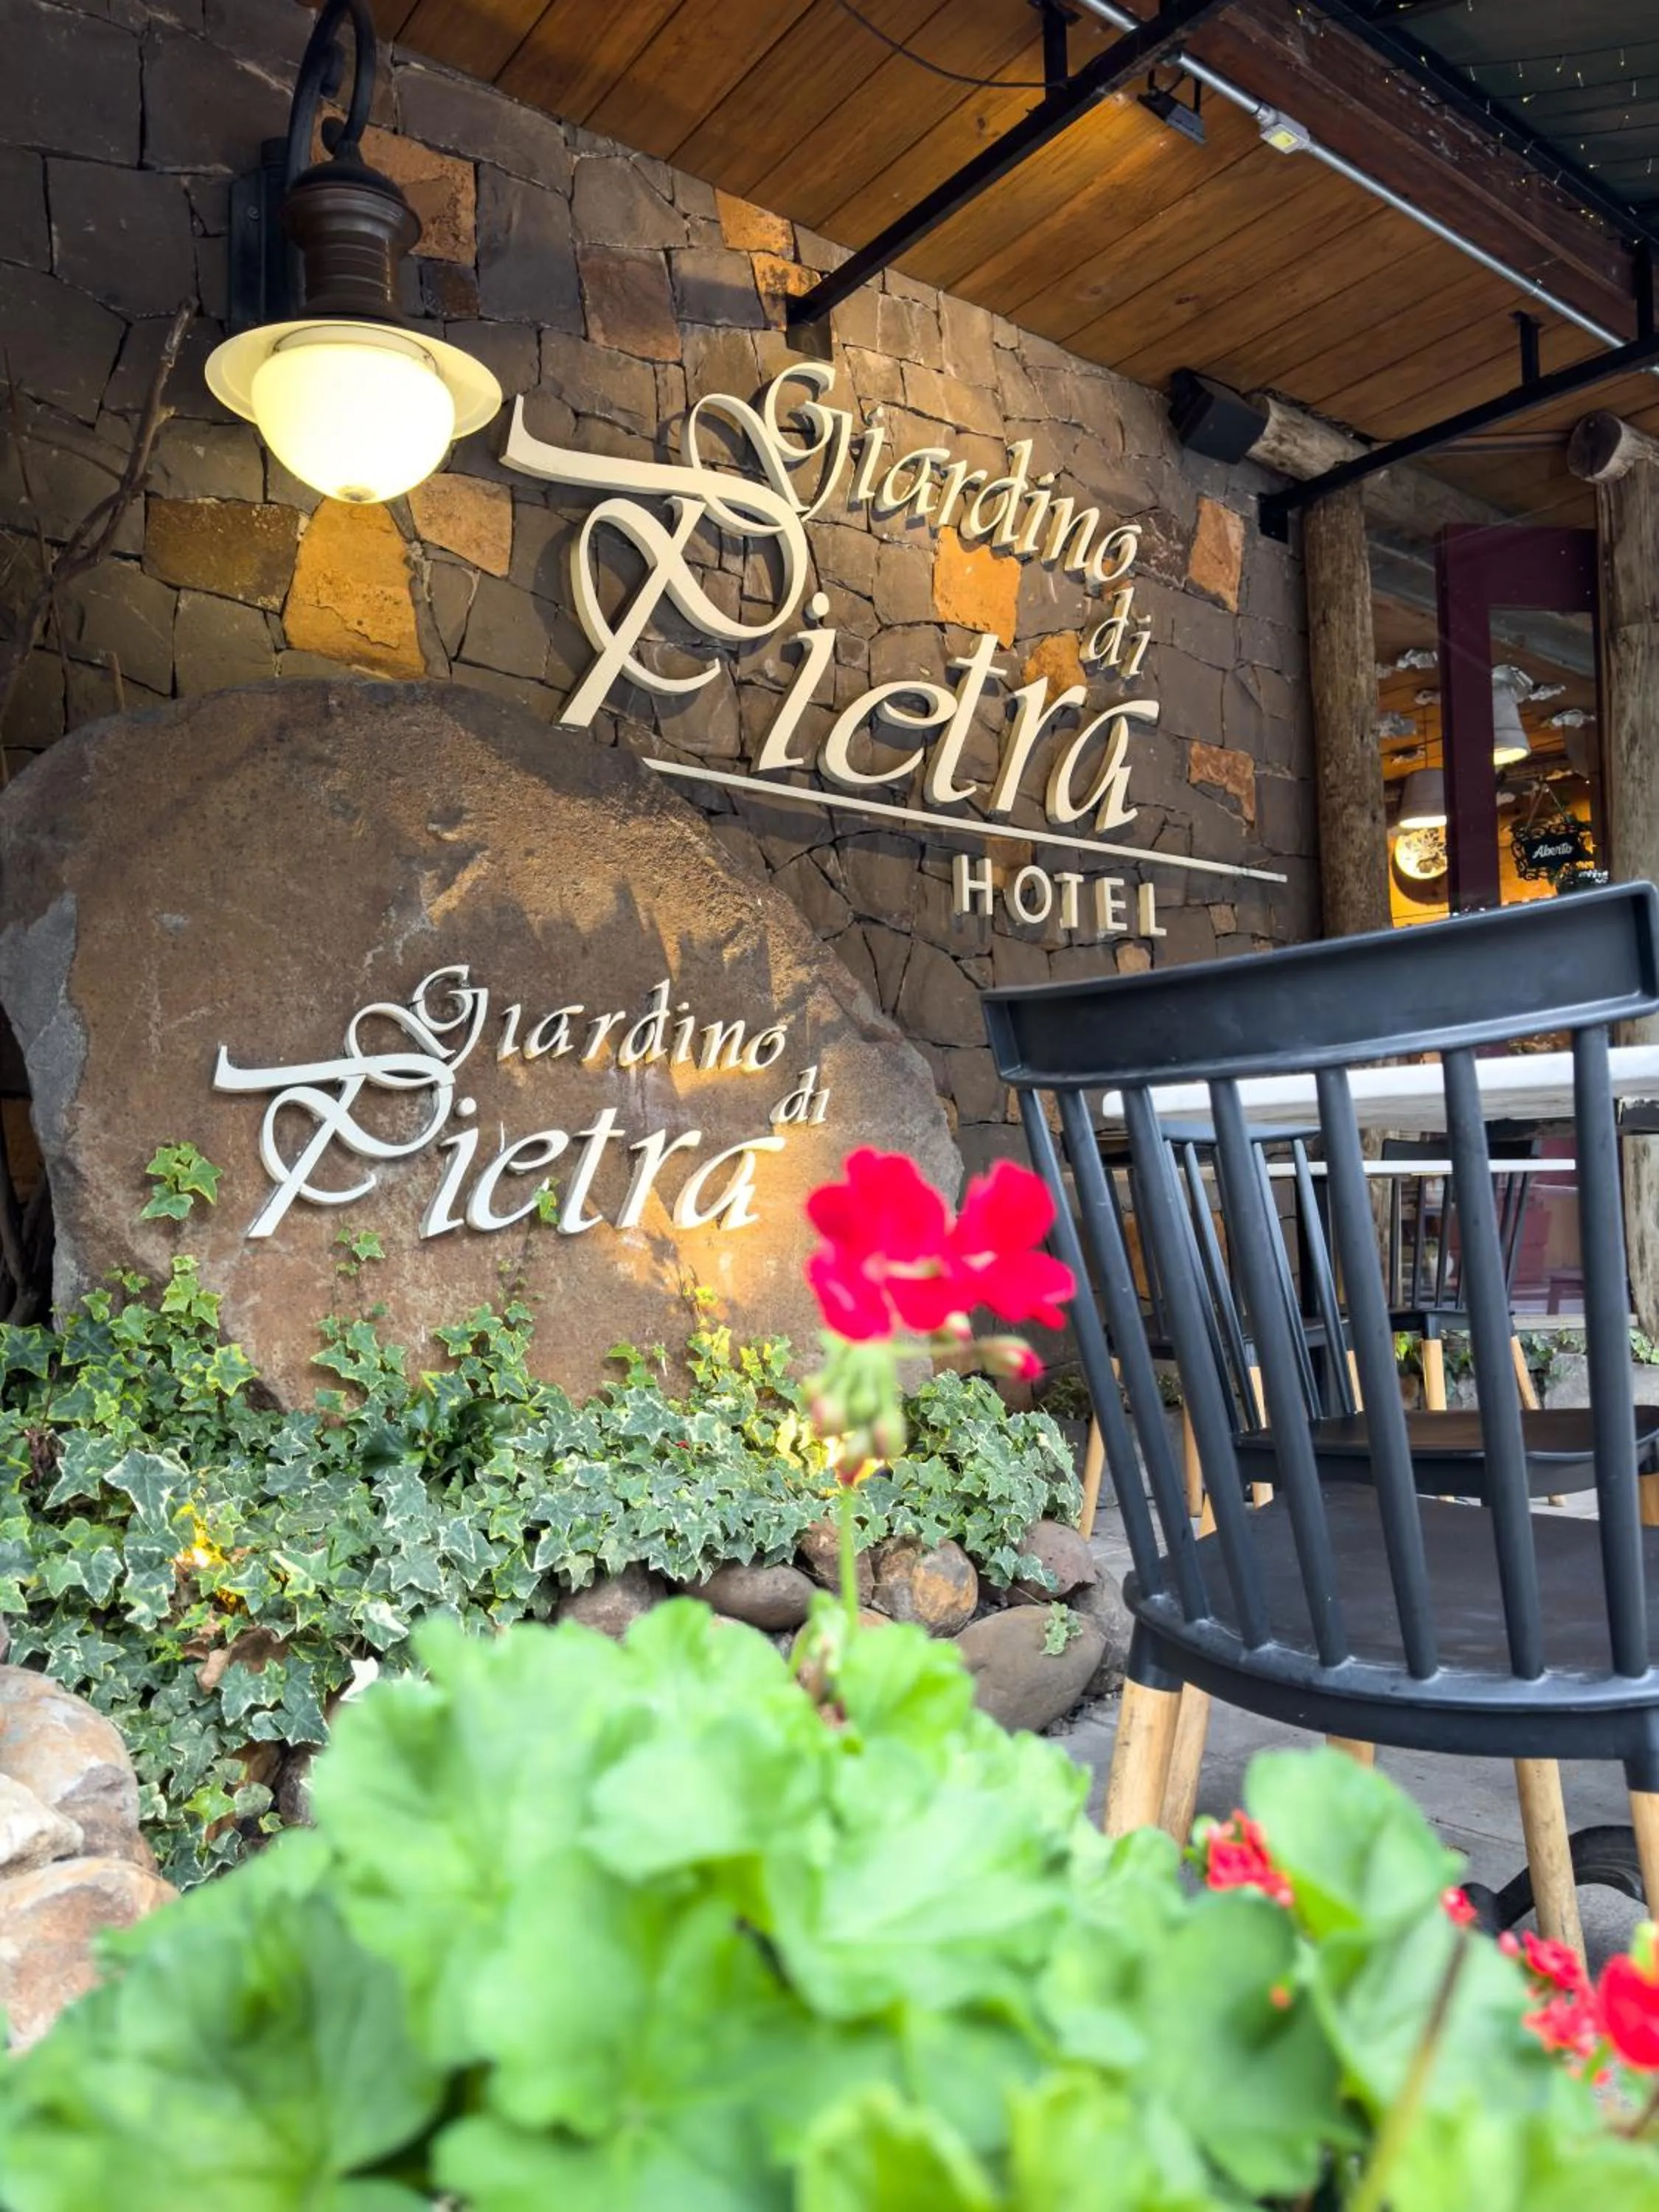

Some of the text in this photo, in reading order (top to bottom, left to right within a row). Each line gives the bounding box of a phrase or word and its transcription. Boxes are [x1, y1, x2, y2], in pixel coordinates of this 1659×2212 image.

[762, 363, 1141, 583] Giardino
[500, 394, 1160, 831] Pietra
[1082, 591, 1152, 678] di
[953, 854, 1167, 938] HOTEL
[410, 965, 787, 1074] Giardino
[212, 1003, 786, 1239] Pietra
